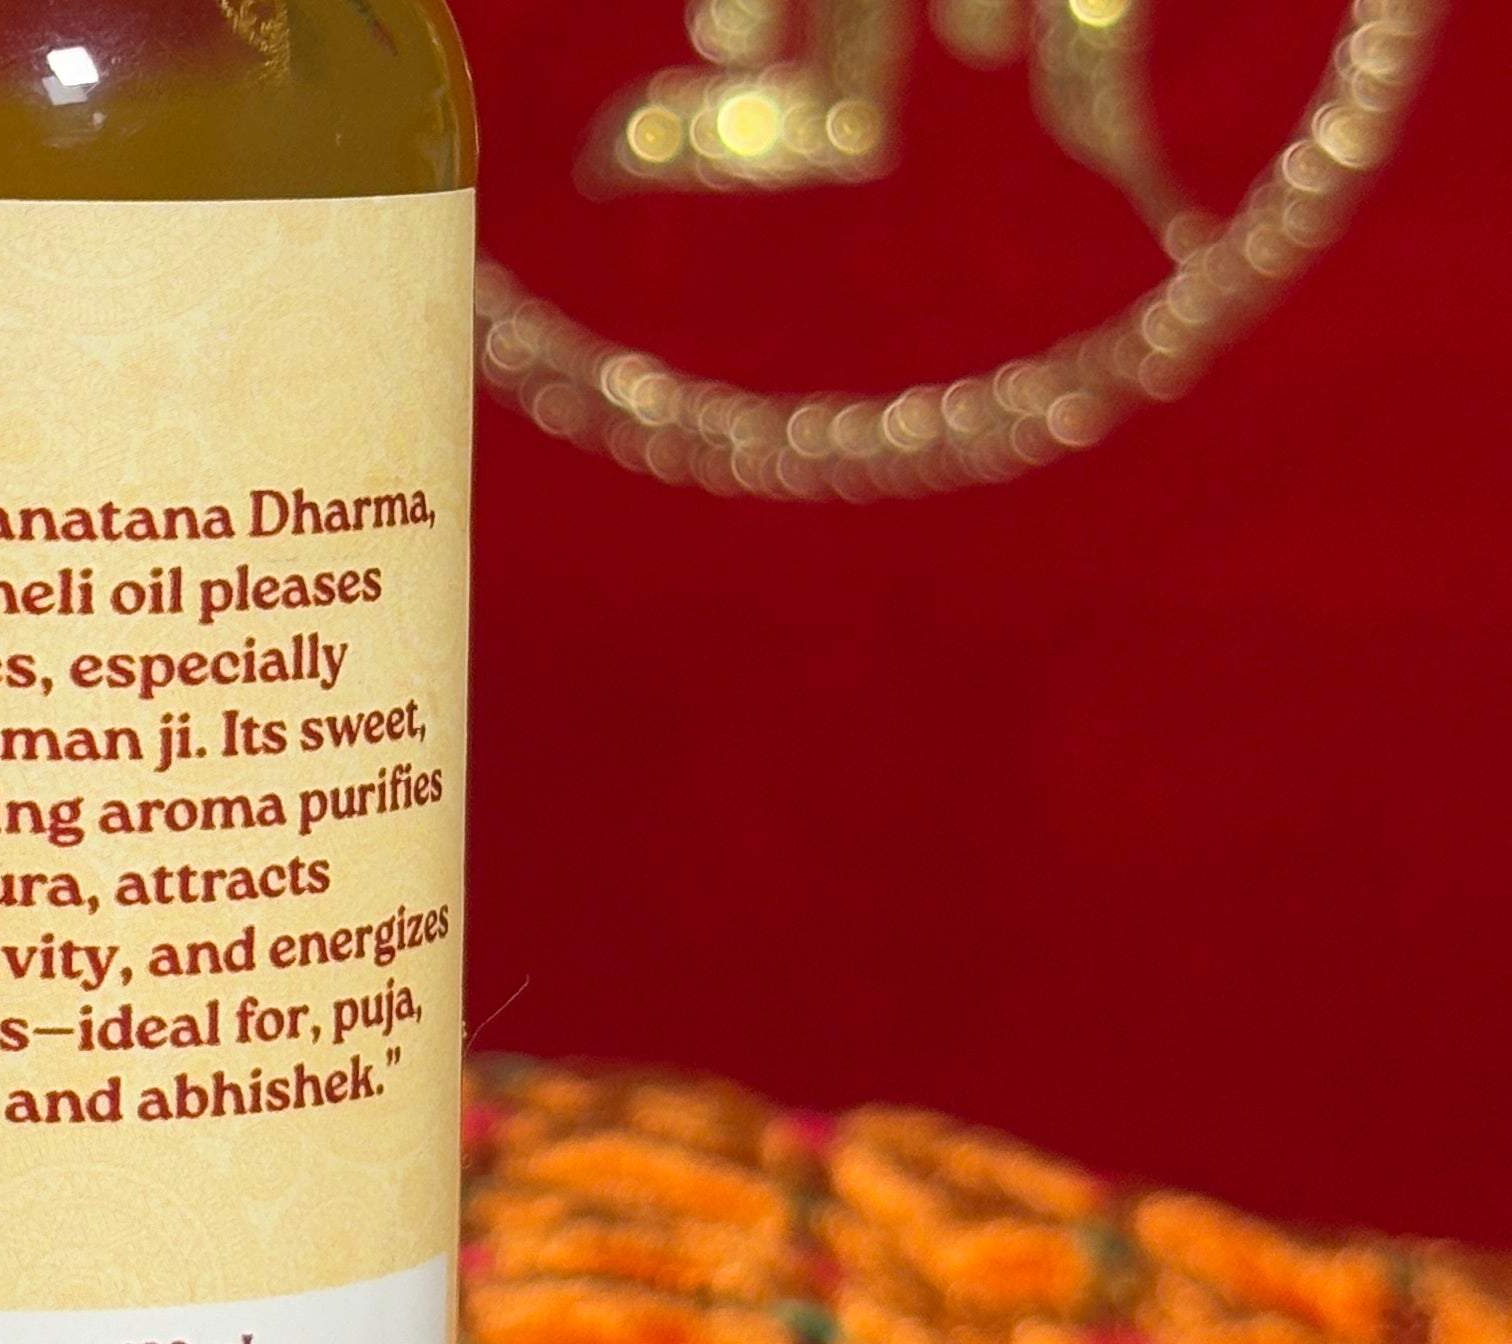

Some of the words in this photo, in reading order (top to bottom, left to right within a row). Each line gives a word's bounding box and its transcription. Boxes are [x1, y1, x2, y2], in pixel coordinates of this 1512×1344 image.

[248, 489, 435, 537] Dharma,
[111, 566, 182, 613] oil
[199, 565, 381, 623] pleases
[70, 633, 347, 699] especially
[154, 713, 207, 772] ji.
[223, 710, 287, 756] Its
[300, 700, 426, 750] sweet,
[99, 788, 287, 834] aroma
[298, 763, 443, 836] purifies
[115, 856, 330, 906] attracts
[148, 925, 256, 977] and
[268, 904, 449, 969] energizes
[235, 997, 321, 1044] for,
[332, 977, 422, 1037] puja,
[5, 1077, 122, 1123] and
